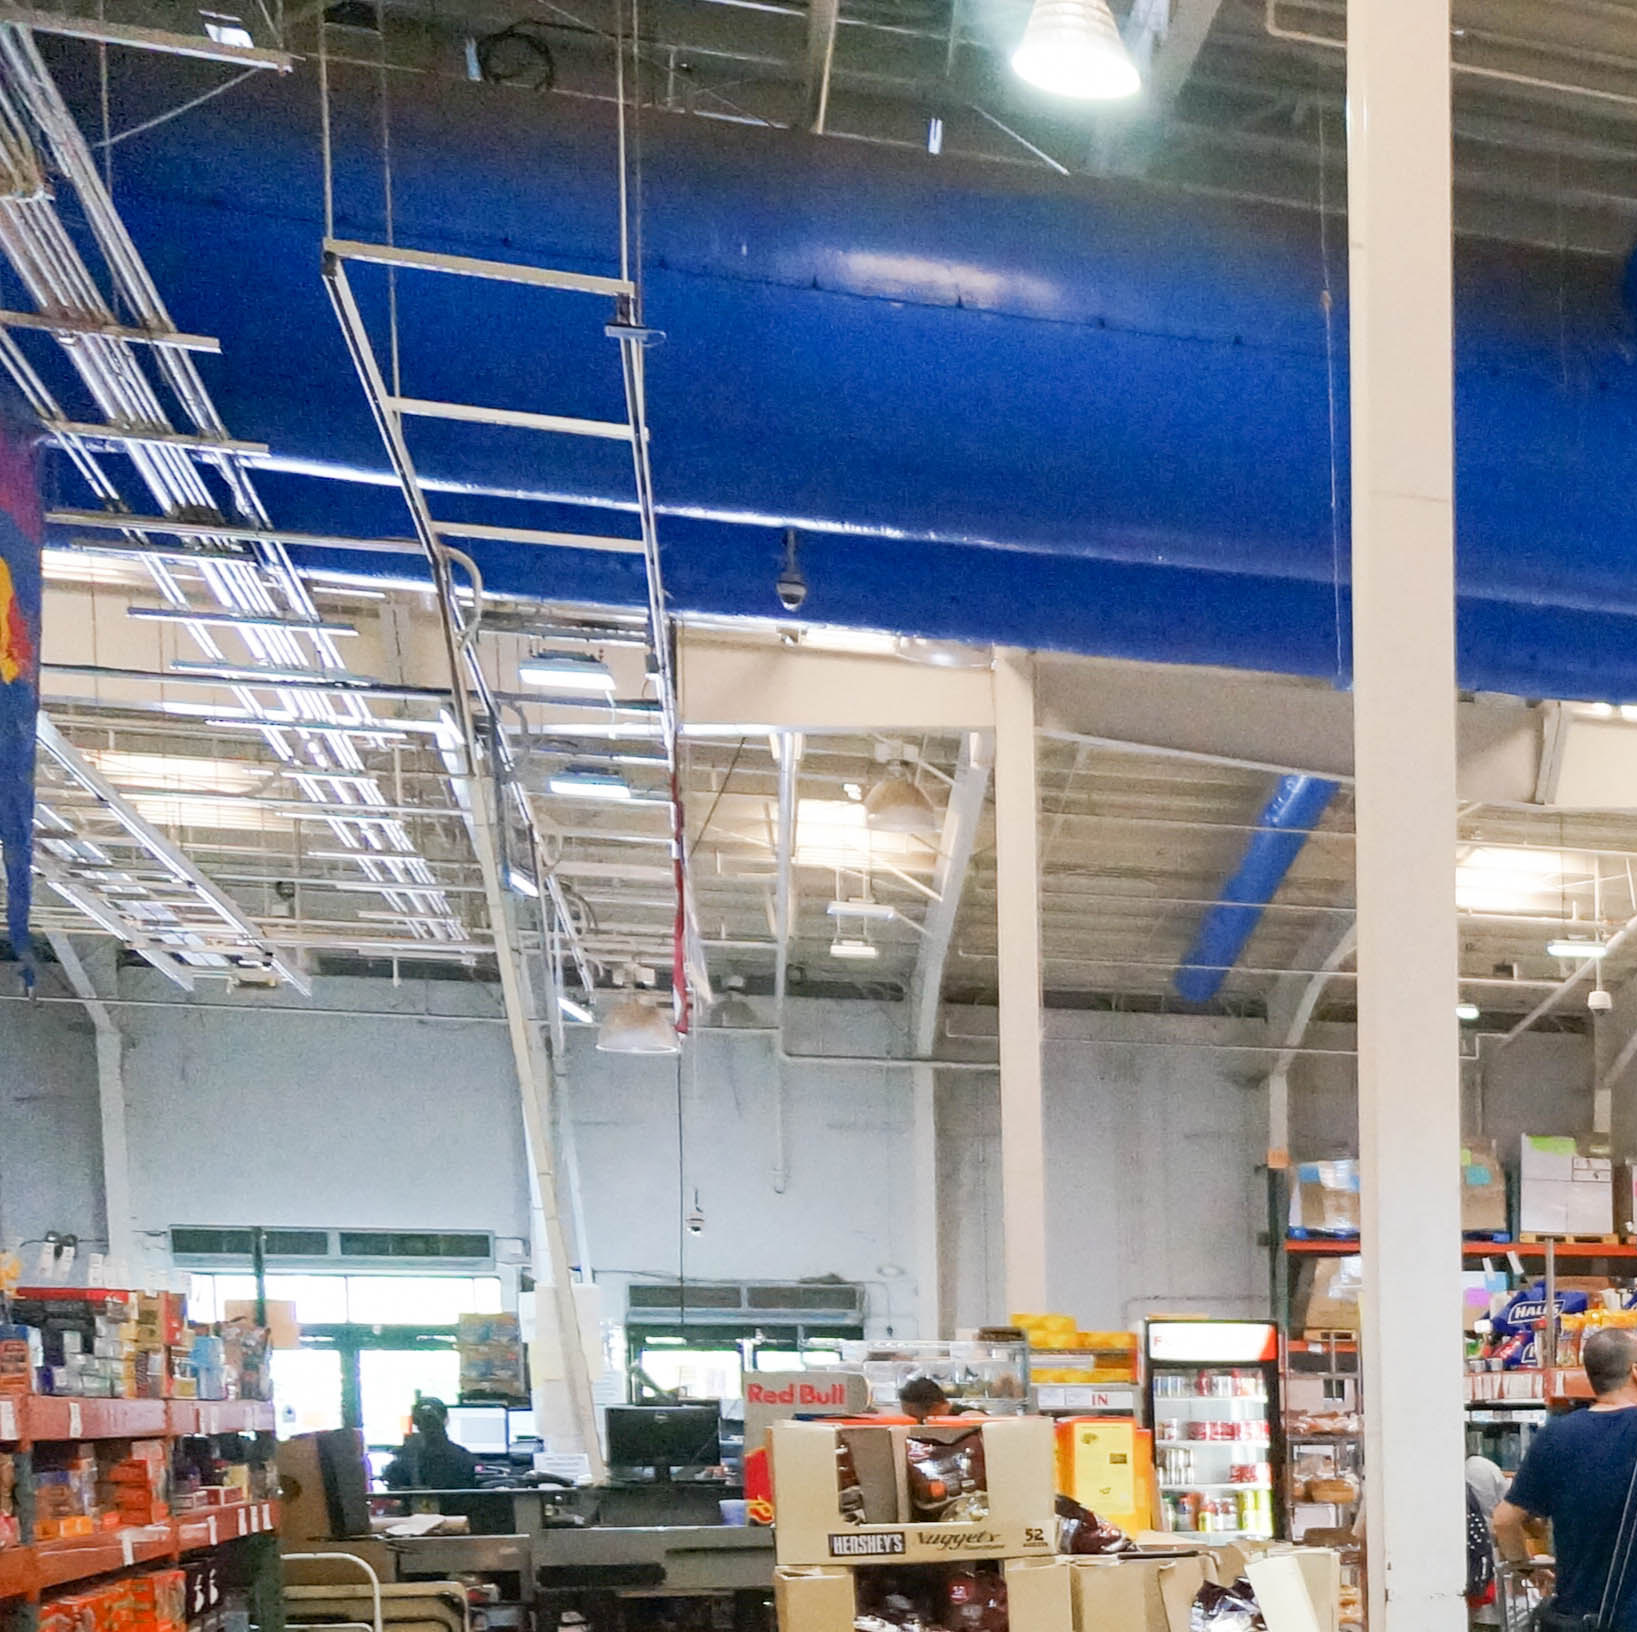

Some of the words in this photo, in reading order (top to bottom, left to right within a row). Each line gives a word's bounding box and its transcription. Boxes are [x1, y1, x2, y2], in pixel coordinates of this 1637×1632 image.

[1514, 1304, 1564, 1319] HALS
[747, 1383, 794, 1406] Red
[798, 1383, 845, 1406] Bull
[1091, 1393, 1110, 1407] IN
[832, 1534, 904, 1555] HERSHEY'S
[1024, 1527, 1044, 1542] 52
